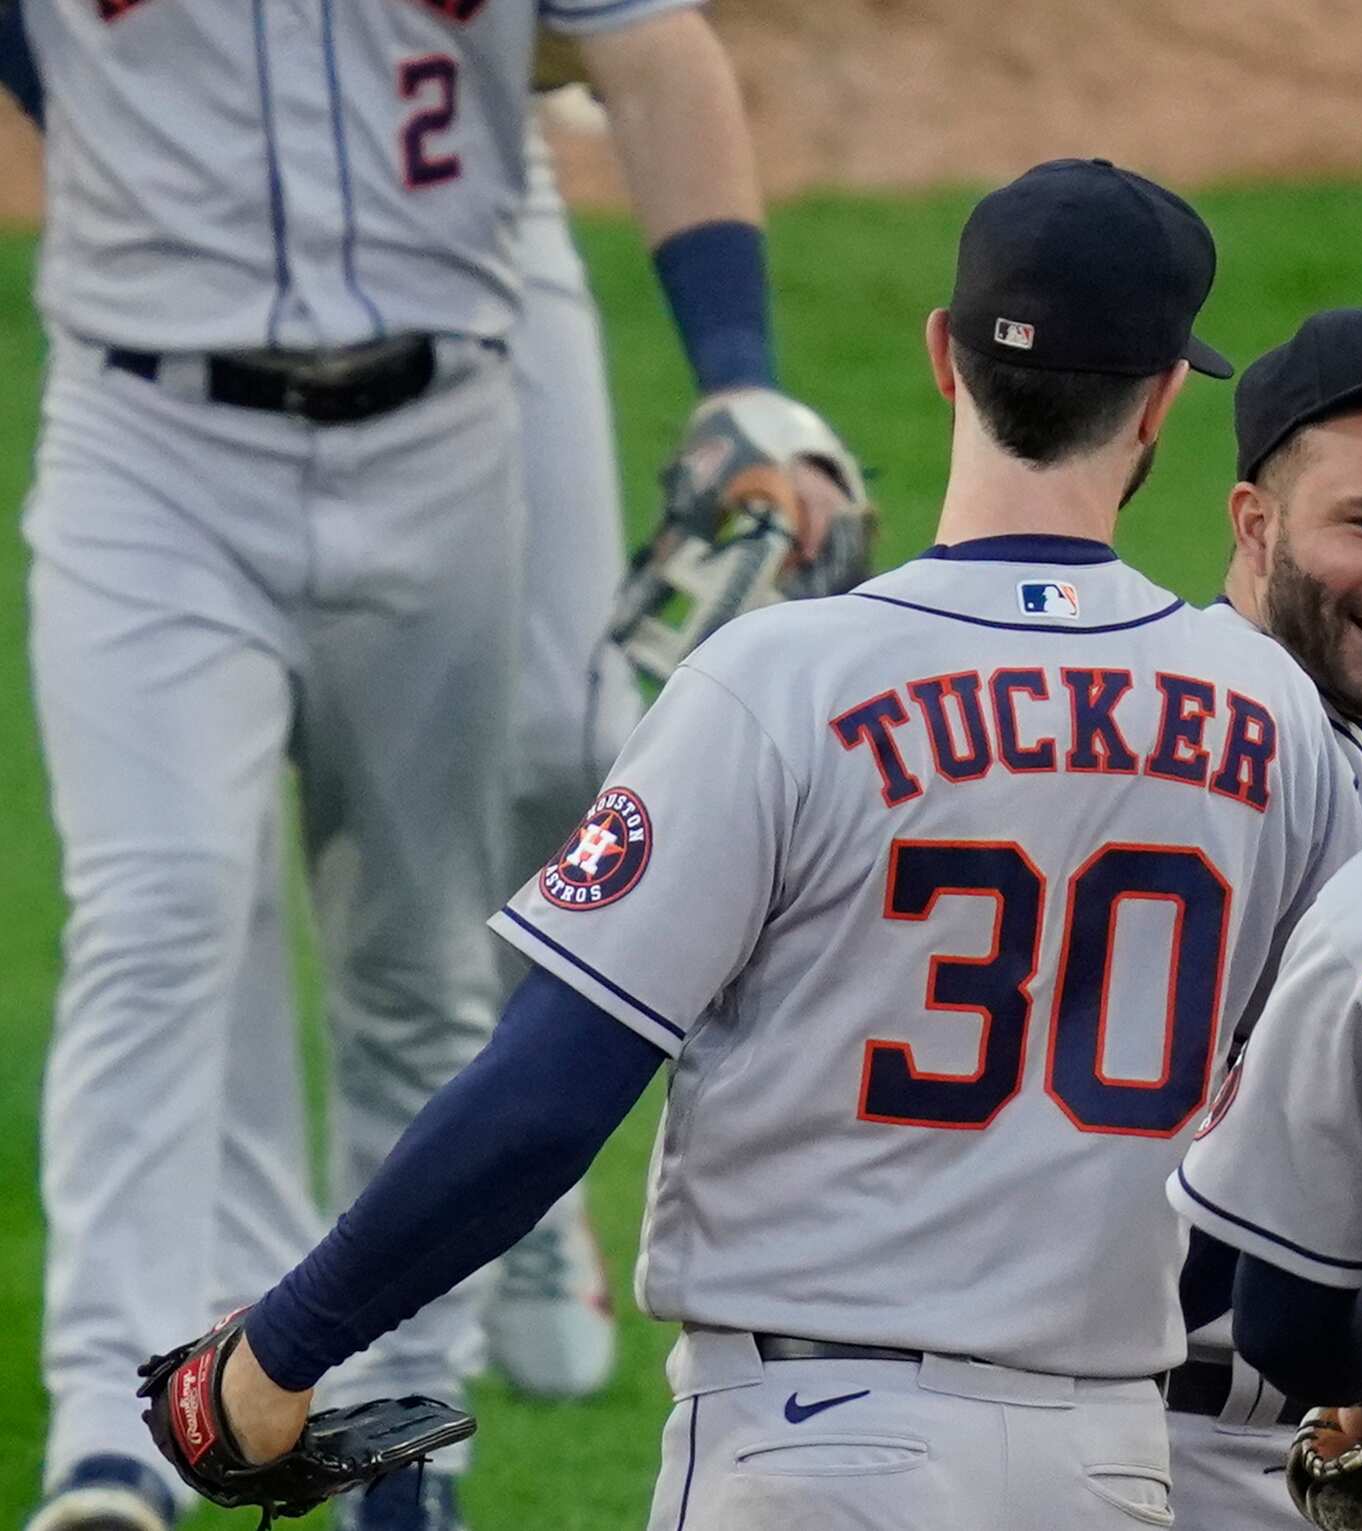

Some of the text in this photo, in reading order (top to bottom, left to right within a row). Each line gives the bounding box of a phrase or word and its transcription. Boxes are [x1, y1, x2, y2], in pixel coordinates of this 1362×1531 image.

[397, 52, 462, 191] 2
[828, 666, 1277, 813] TUCKER
[565, 823, 618, 876] H
[856, 838, 1234, 1140] 30
